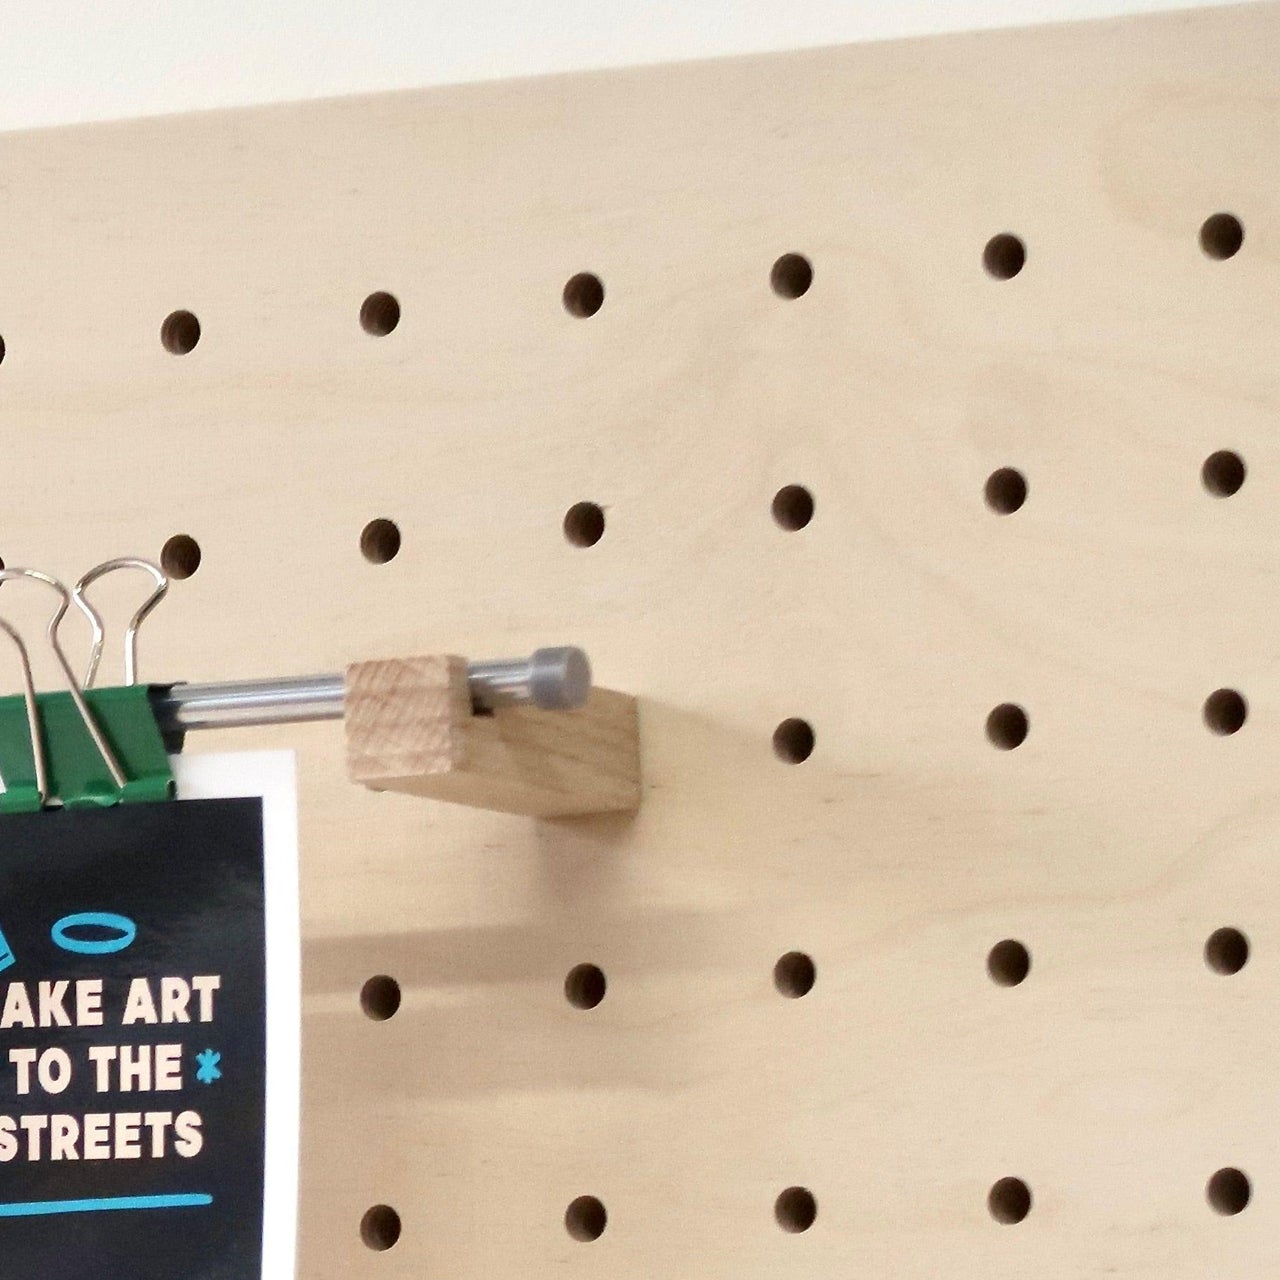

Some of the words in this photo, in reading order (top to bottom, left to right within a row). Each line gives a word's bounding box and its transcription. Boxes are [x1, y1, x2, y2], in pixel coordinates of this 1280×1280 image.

[121, 975, 222, 1026] ART
[8, 1046, 72, 1095] TO
[88, 1043, 184, 1093] THE
